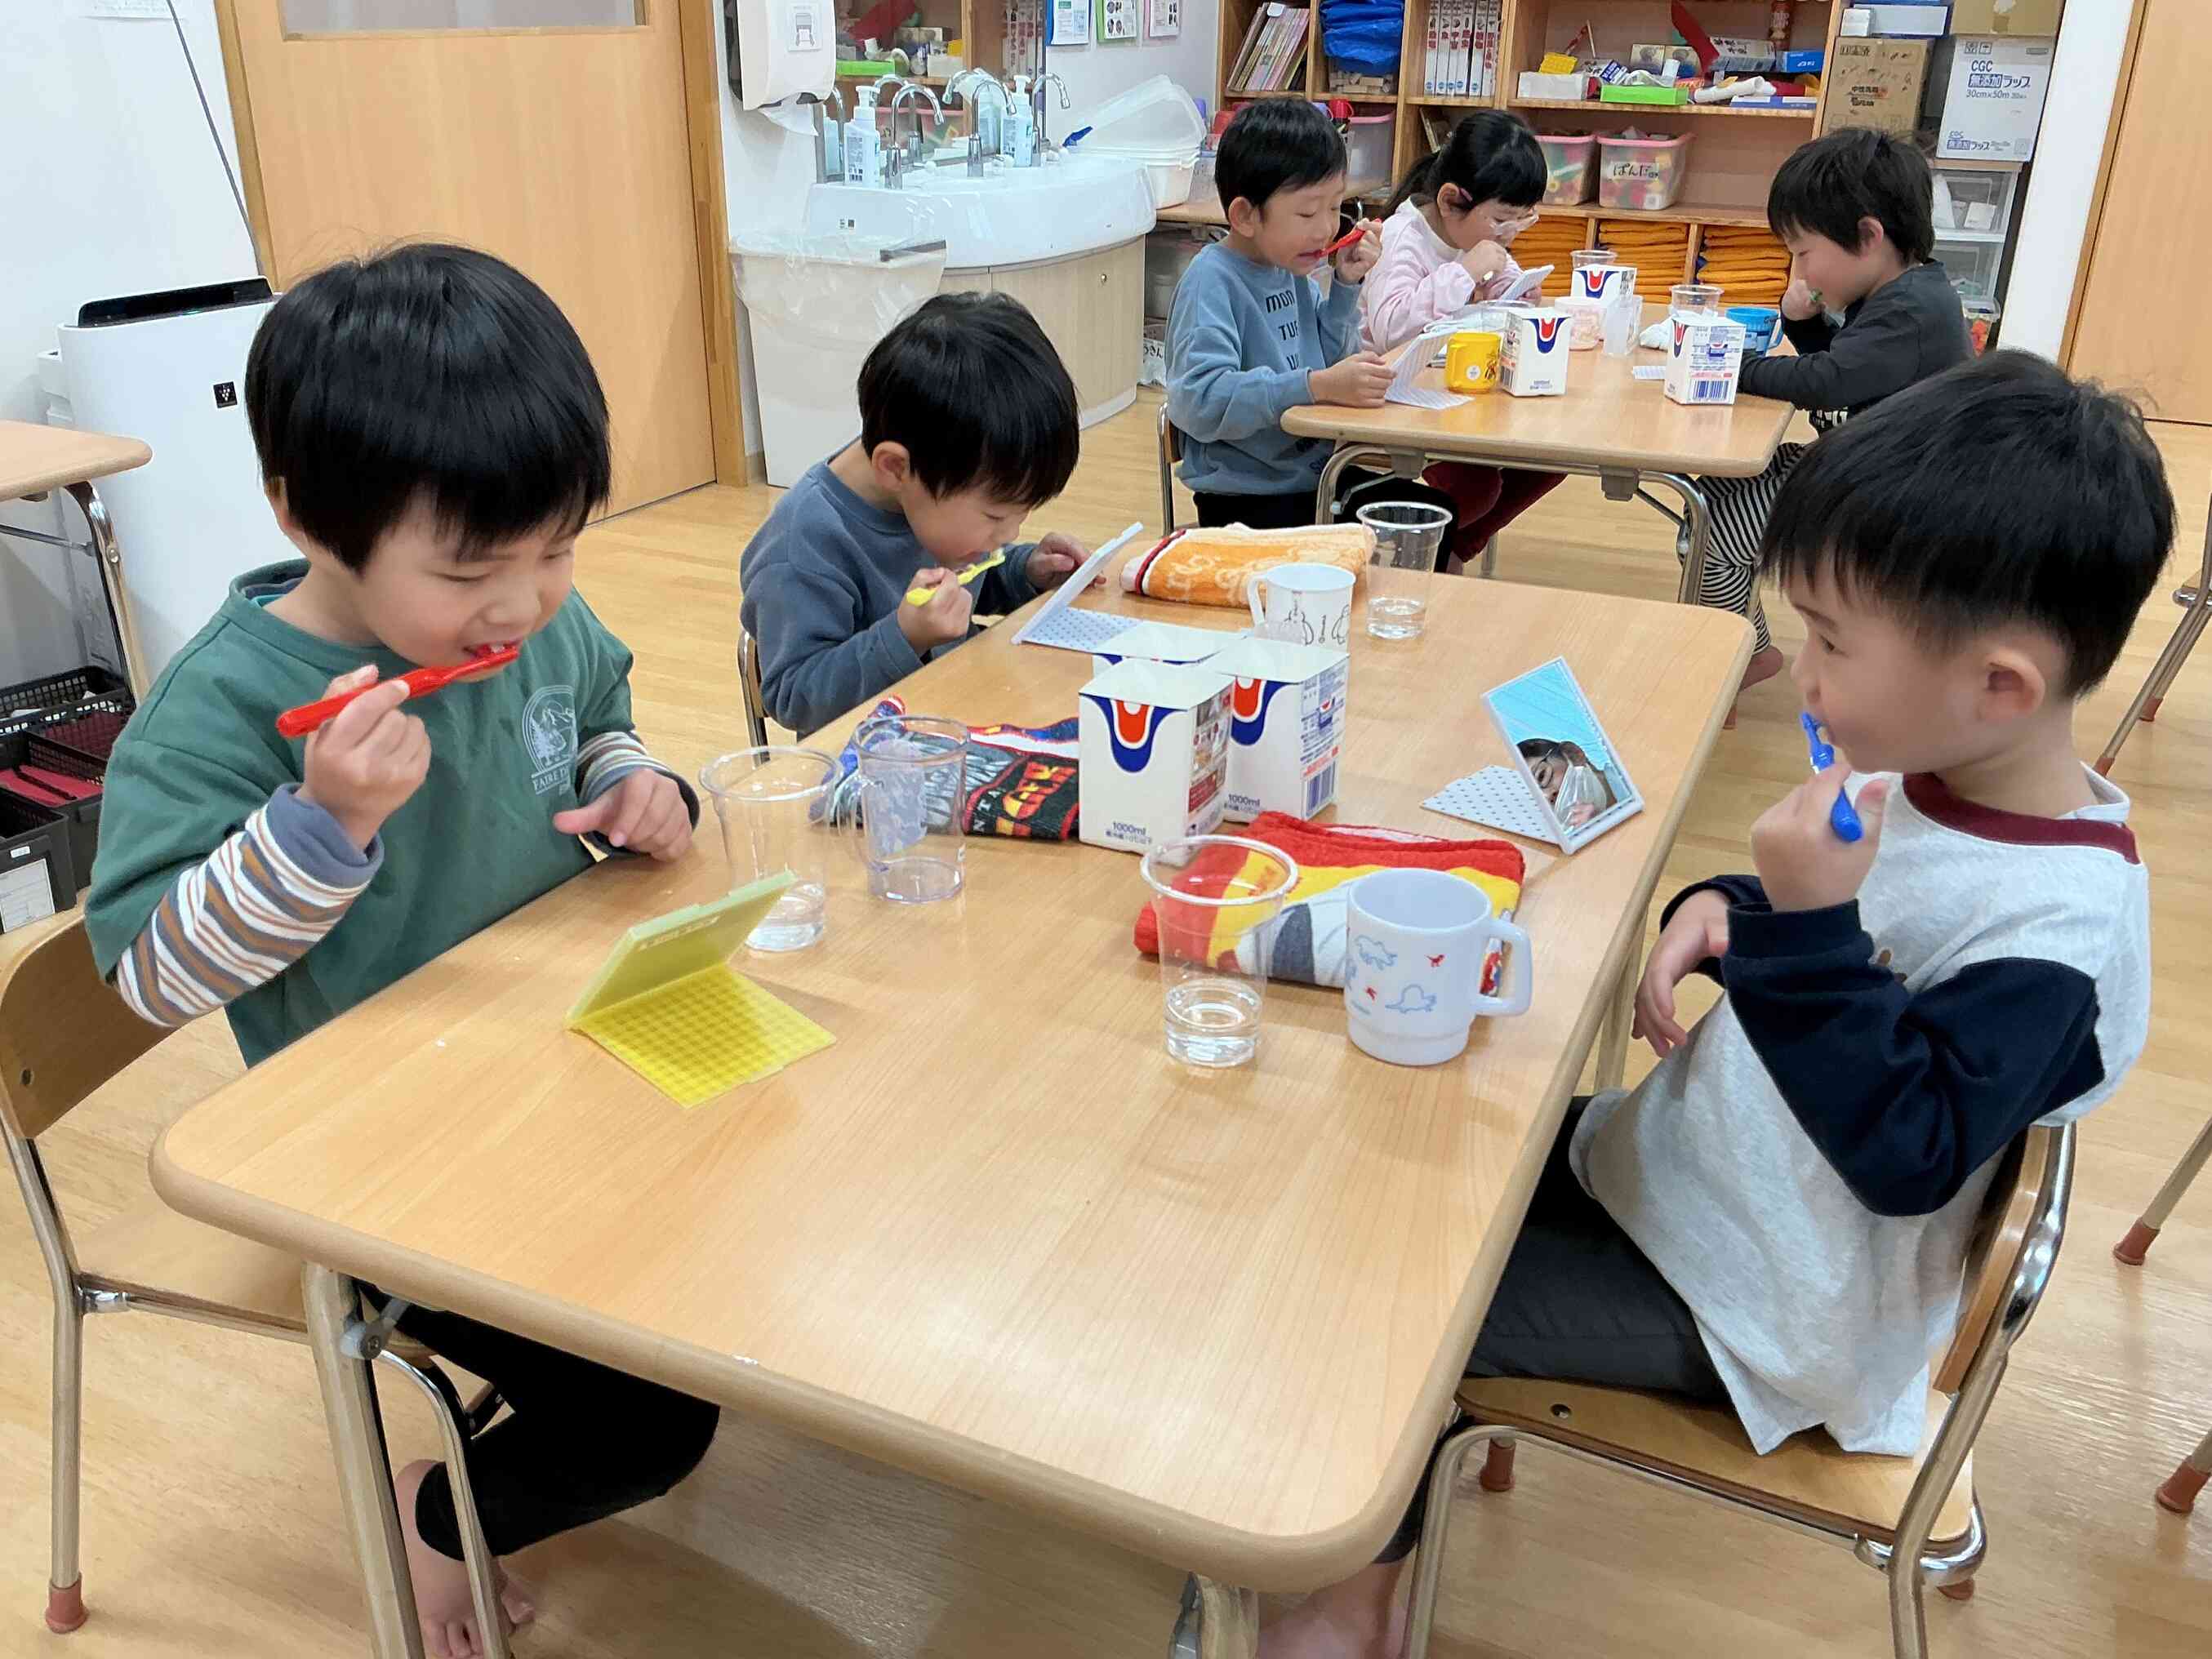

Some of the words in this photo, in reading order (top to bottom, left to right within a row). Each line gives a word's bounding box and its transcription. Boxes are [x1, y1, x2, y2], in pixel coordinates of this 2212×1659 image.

[1971, 60, 1993, 72] CGC
[1279, 321, 1298, 340] TU
[1228, 794, 1260, 807] 1000ml
[1113, 821, 1146, 835] 1000ml
